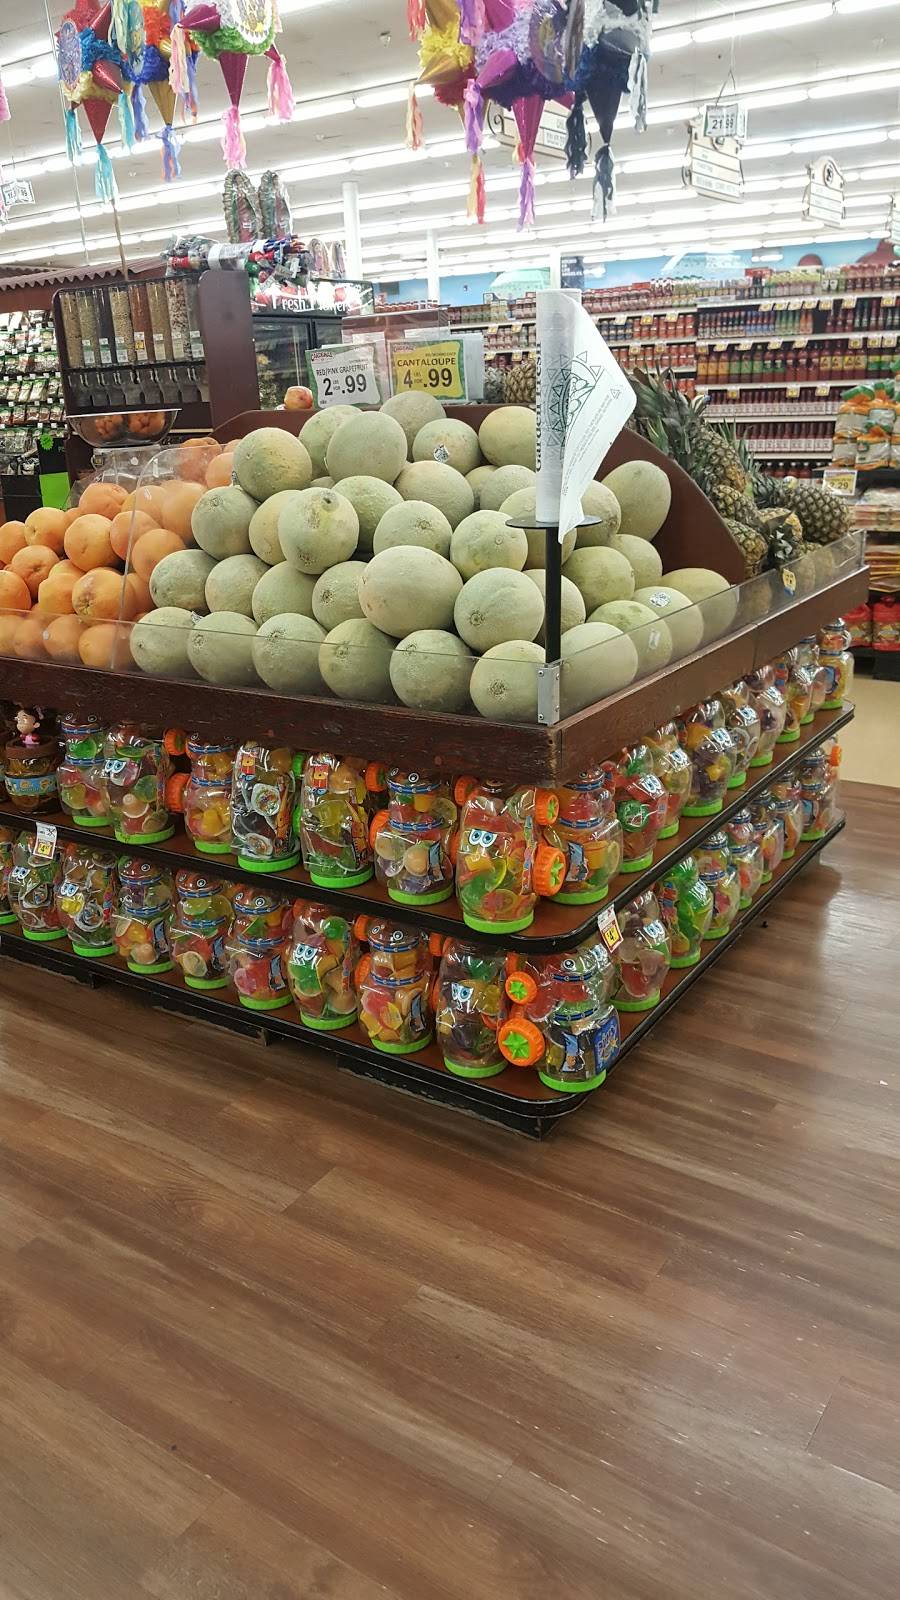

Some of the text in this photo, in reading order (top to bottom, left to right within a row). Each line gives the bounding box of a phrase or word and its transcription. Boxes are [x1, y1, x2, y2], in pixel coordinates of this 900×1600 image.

[339, 363, 369, 374] GRAPEFRUIT
[397, 357, 456, 367] CANTALOUPE
[403, 369, 413, 388] 4
[322, 377, 333, 396] 2
